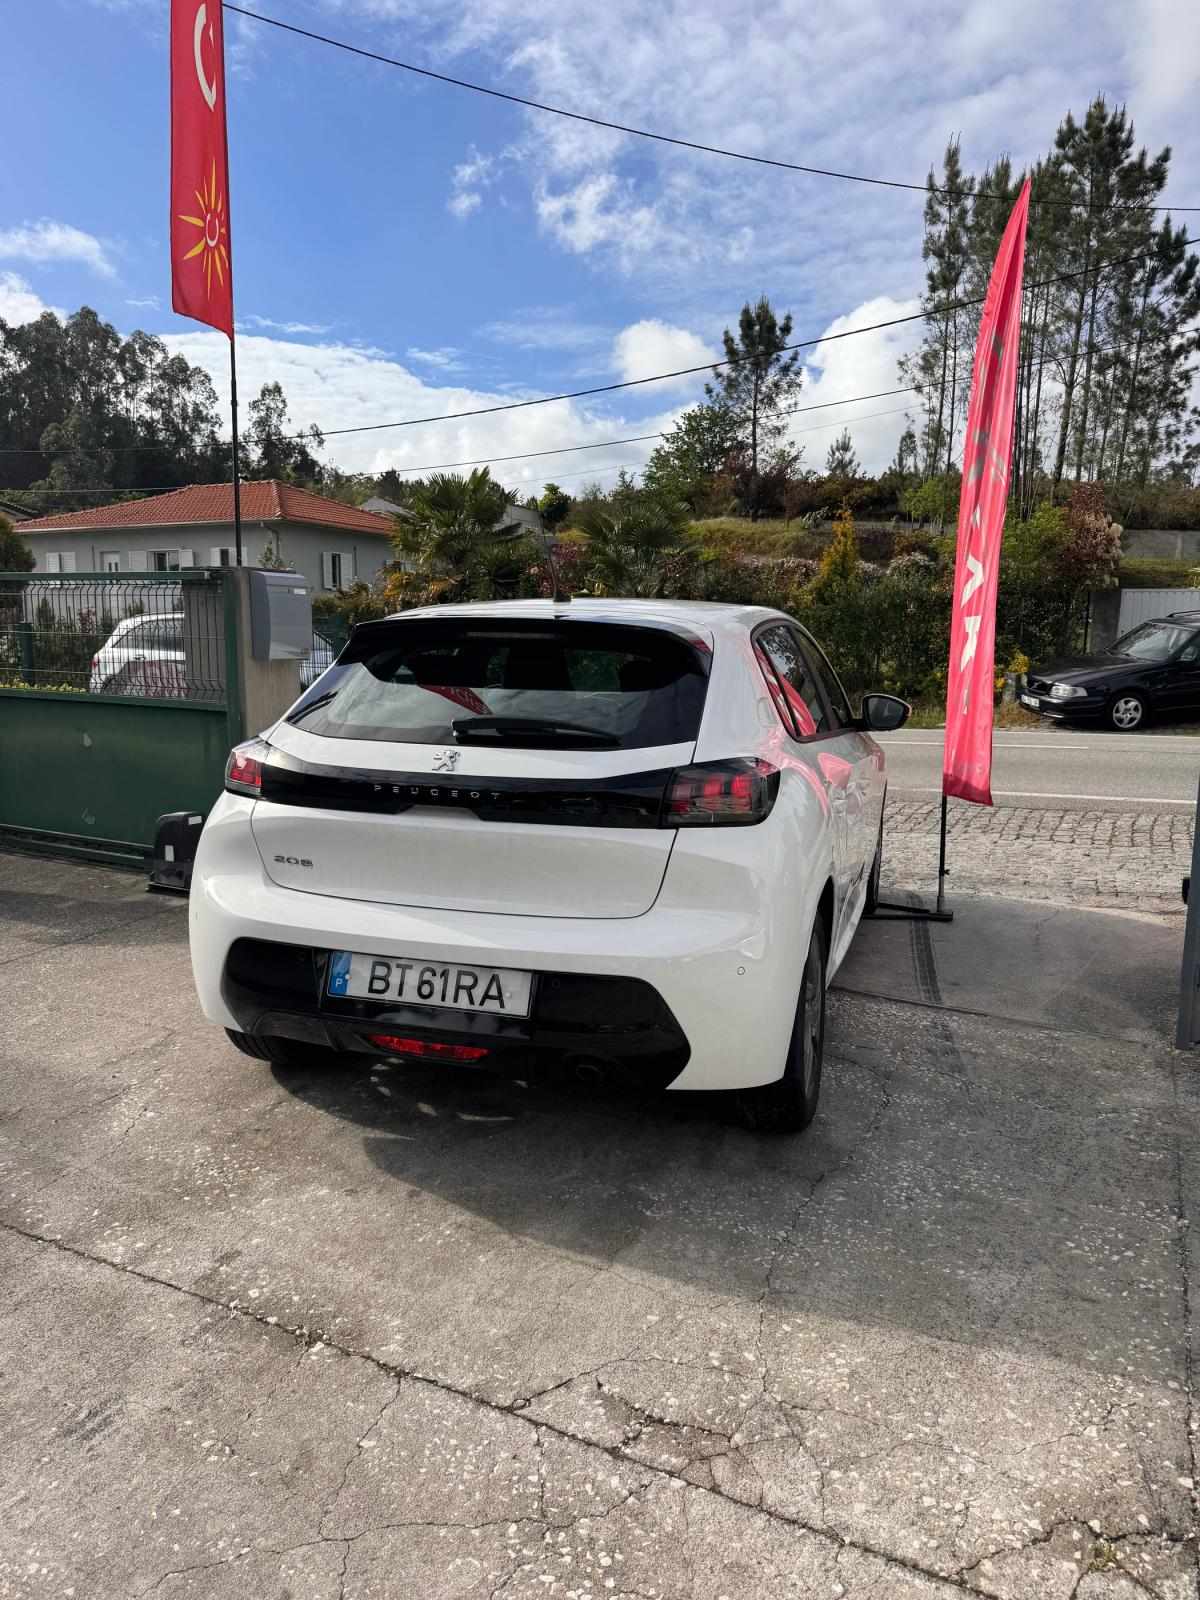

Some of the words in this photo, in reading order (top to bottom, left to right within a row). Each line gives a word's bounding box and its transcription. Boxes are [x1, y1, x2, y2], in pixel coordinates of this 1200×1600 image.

[373, 784, 500, 800] PEUGEOT
[273, 855, 314, 868] 208
[335, 977, 344, 988] P
